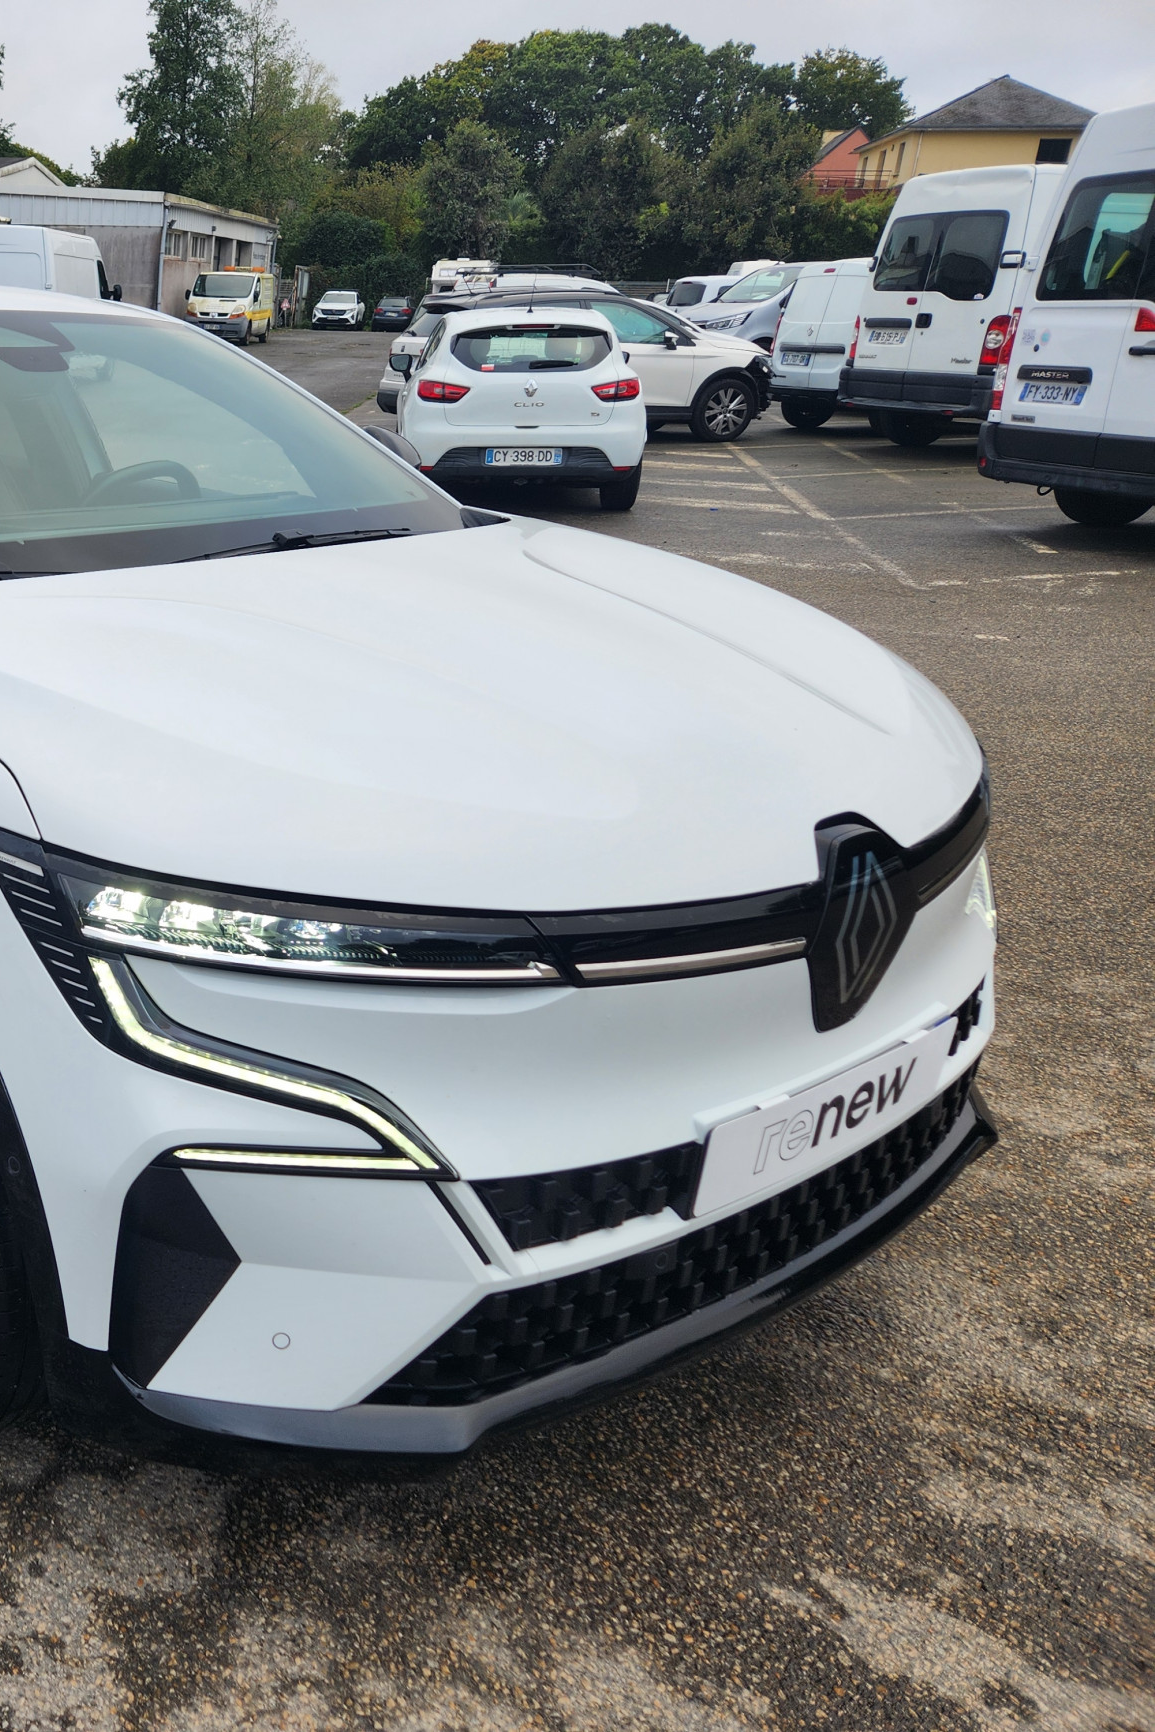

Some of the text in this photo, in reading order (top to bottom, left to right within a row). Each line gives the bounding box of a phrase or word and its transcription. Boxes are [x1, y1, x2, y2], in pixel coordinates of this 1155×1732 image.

[1031, 370, 1070, 379] MASTER
[494, 450, 553, 463] CY-398-DD
[753, 1056, 917, 1175] renew
